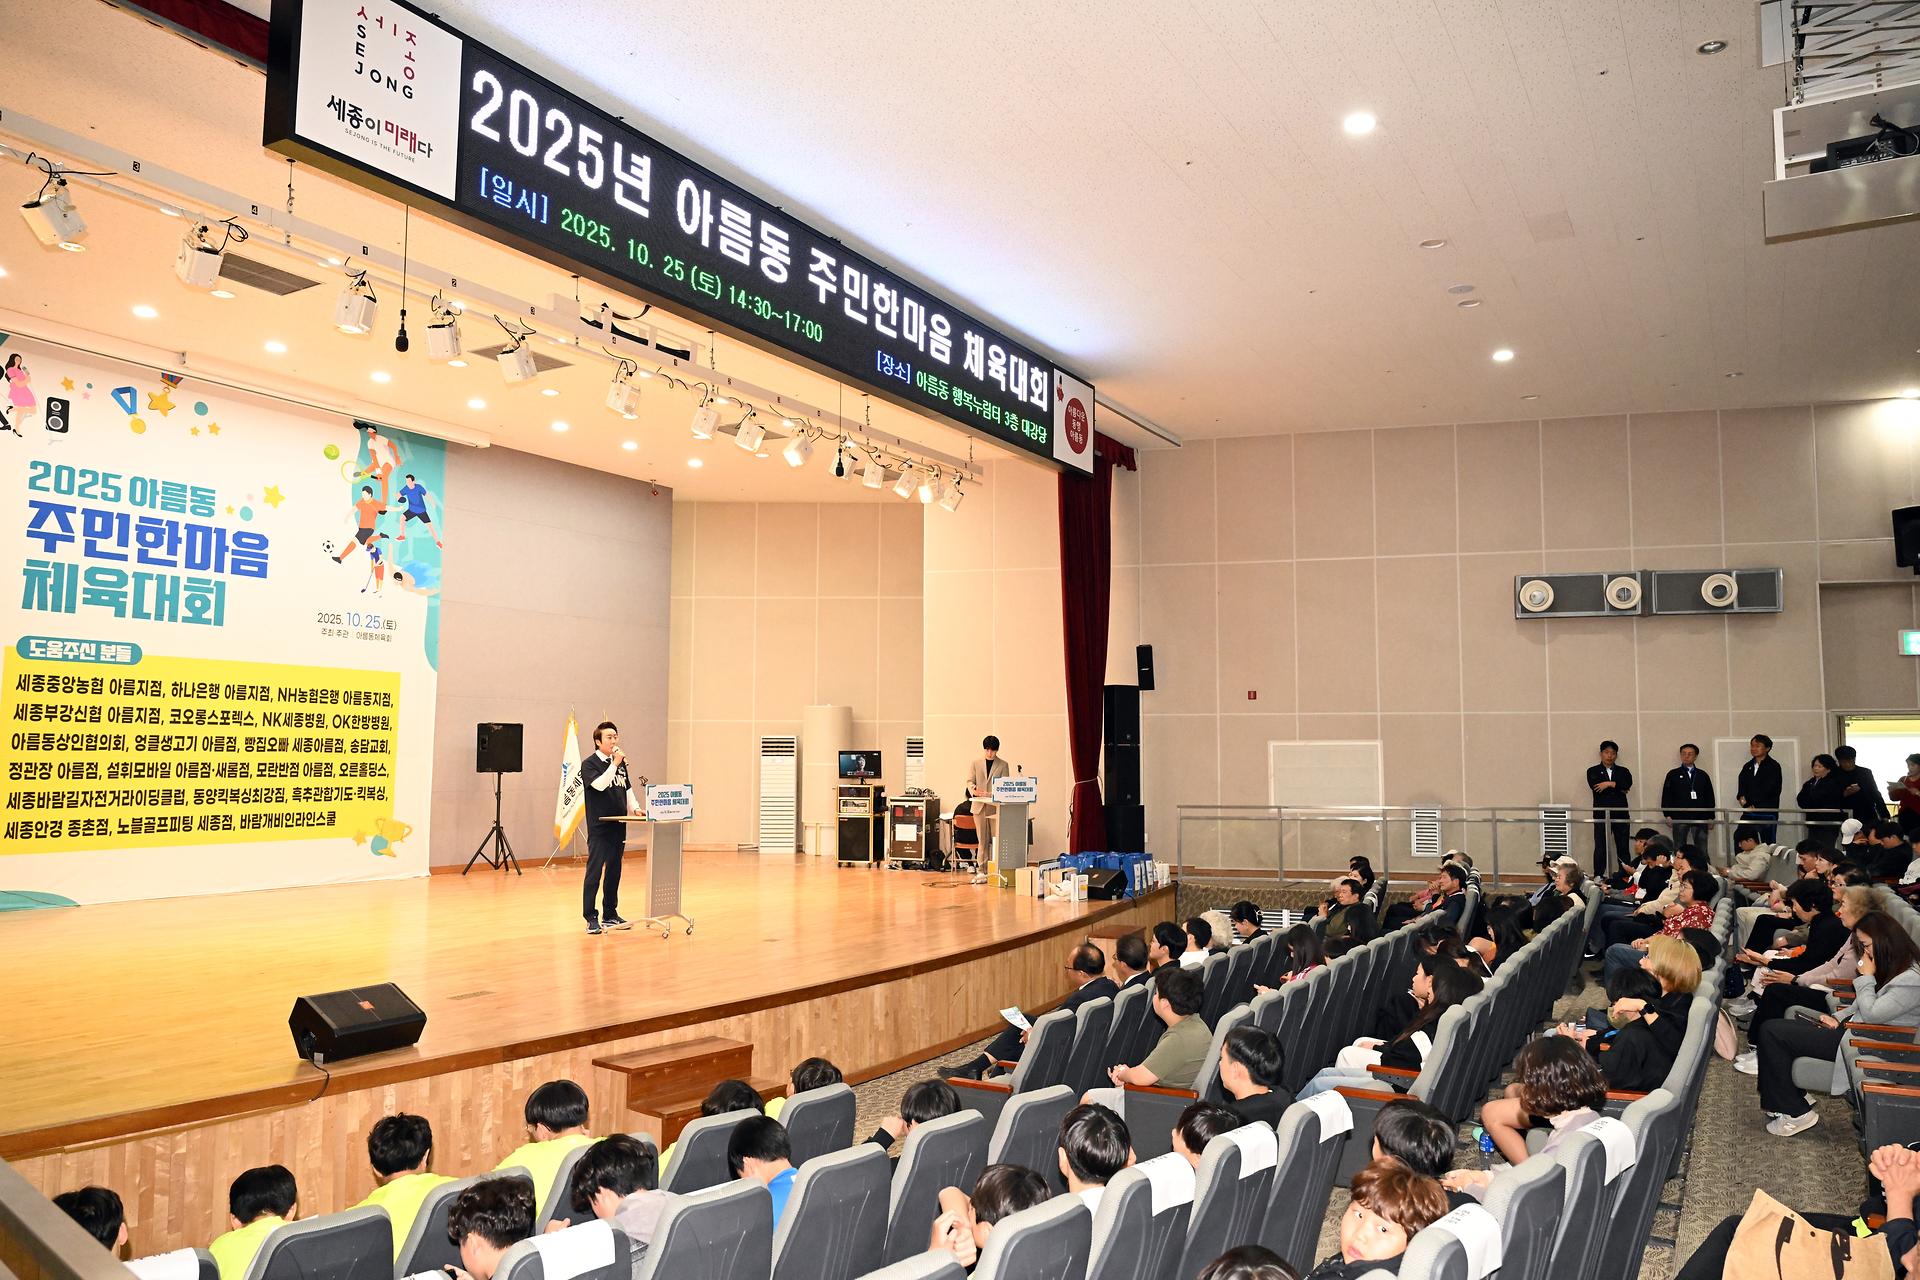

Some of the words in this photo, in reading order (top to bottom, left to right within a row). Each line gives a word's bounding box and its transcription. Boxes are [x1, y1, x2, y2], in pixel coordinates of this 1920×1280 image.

[345, 128, 369, 143] SEJONG
[380, 143, 391, 153] THE
[392, 148, 415, 163] FUTURE
[470, 69, 651, 218] 2025년
[676, 178, 791, 284] 아름동
[808, 246, 952, 365] 주민한마음
[963, 328, 1049, 413] 체육대회
[481, 167, 549, 225] [일시]
[561, 208, 615, 252] 2025.
[628, 239, 653, 269] 10.
[730, 285, 823, 342] 14:30~17:00
[877, 350, 911, 384] [장소]
[916, 370, 949, 400] 아름동
[952, 386, 1001, 424] 행복누림터
[1004, 411, 1019, 432] 3층
[1021, 418, 1048, 444] 대강당
[28, 460, 122, 503] 2025
[128, 474, 217, 518] 아름동
[26, 499, 270, 580] 주민한마음
[21, 558, 227, 627] 체육대회
[317, 612, 344, 625] 2025.
[29, 638, 97, 661] 도움주신
[100, 644, 132, 663] 분들
[16, 674, 104, 695] 세종중앙농협
[109, 678, 167, 698] 아름지점,
[171, 681, 220, 699] 하나은행
[224, 684, 273, 702] 아름지점,
[277, 687, 340, 704] NH농협은행
[343, 690, 394, 708] 아름동지점,
[13, 703, 102, 723] 세종부강신협
[108, 706, 164, 725] 아름지점,
[169, 708, 257, 728] 코오롱스포렉스,
[262, 711, 328, 730] NK세종병원,
[332, 714, 393, 731] OK한방병원,
[11, 732, 129, 752] 아름동상인협의회,
[134, 734, 197, 751] 엉클생고기
[202, 736, 240, 753] 아름점,
[244, 737, 289, 752] 빵집오빠
[292, 737, 346, 754] 세종아름점,
[350, 739, 391, 755] 송담교회,
[8, 762, 52, 781] 정관장
[57, 762, 102, 781] 아름점,
[107, 761, 171, 779] 설휘모바일
[175, 762, 253, 779] 아름점·새롬점,
[256, 762, 300, 778] 모란반점
[303, 762, 336, 778] 아름점,
[339, 762, 389, 778] 오른홀딩스,
[6, 789, 188, 810] 세종바람길자전거라이딩클럽,
[193, 786, 288, 805] 동양킥복싱최강짐,
[657, 791, 670, 799] 2025
[4, 820, 63, 840] 세종안경
[67, 818, 112, 837] 종촌점,
[117, 815, 194, 835] 노블골프피팅
[197, 814, 236, 832] 세종점,
[240, 811, 337, 830] 바람개비인라인스쿨
